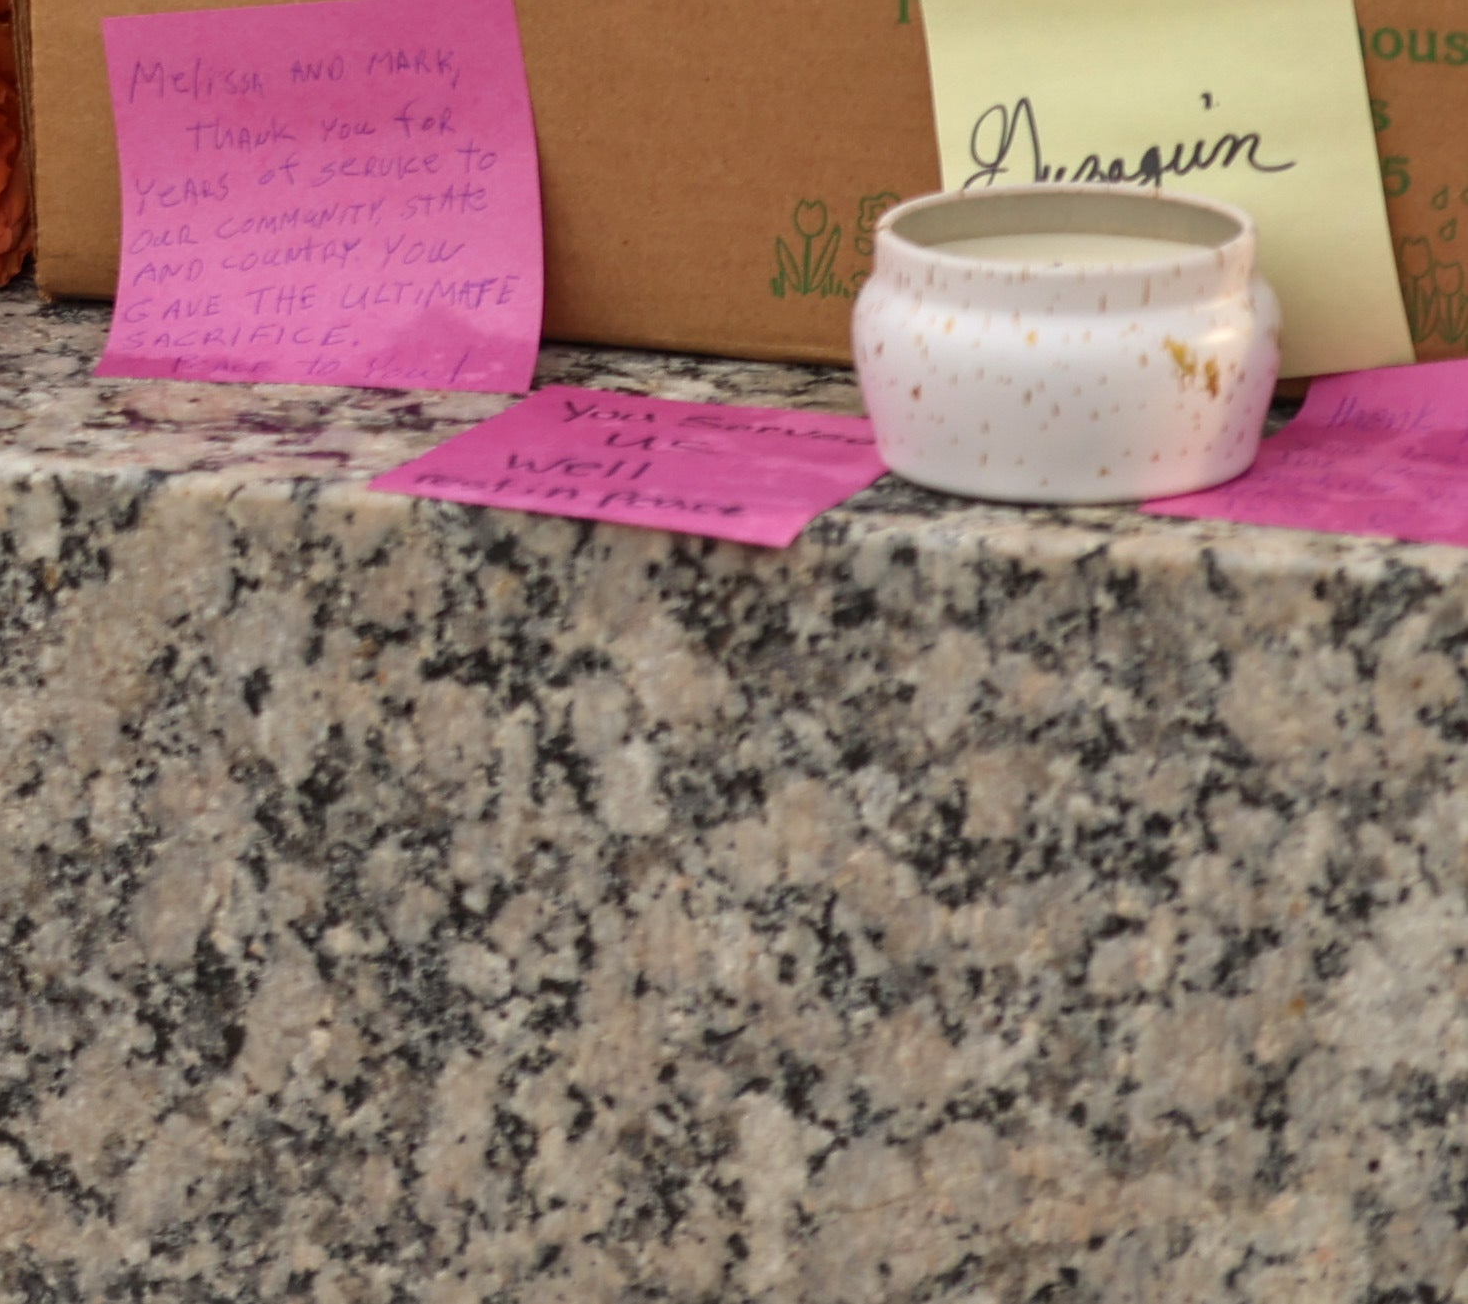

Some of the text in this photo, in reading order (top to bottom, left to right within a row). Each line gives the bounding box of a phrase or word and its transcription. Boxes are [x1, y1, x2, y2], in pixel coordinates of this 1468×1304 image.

[290, 55, 347, 84] AND
[131, 258, 205, 288] AND
[123, 274, 520, 323] GAVE THE ULTIMATE
